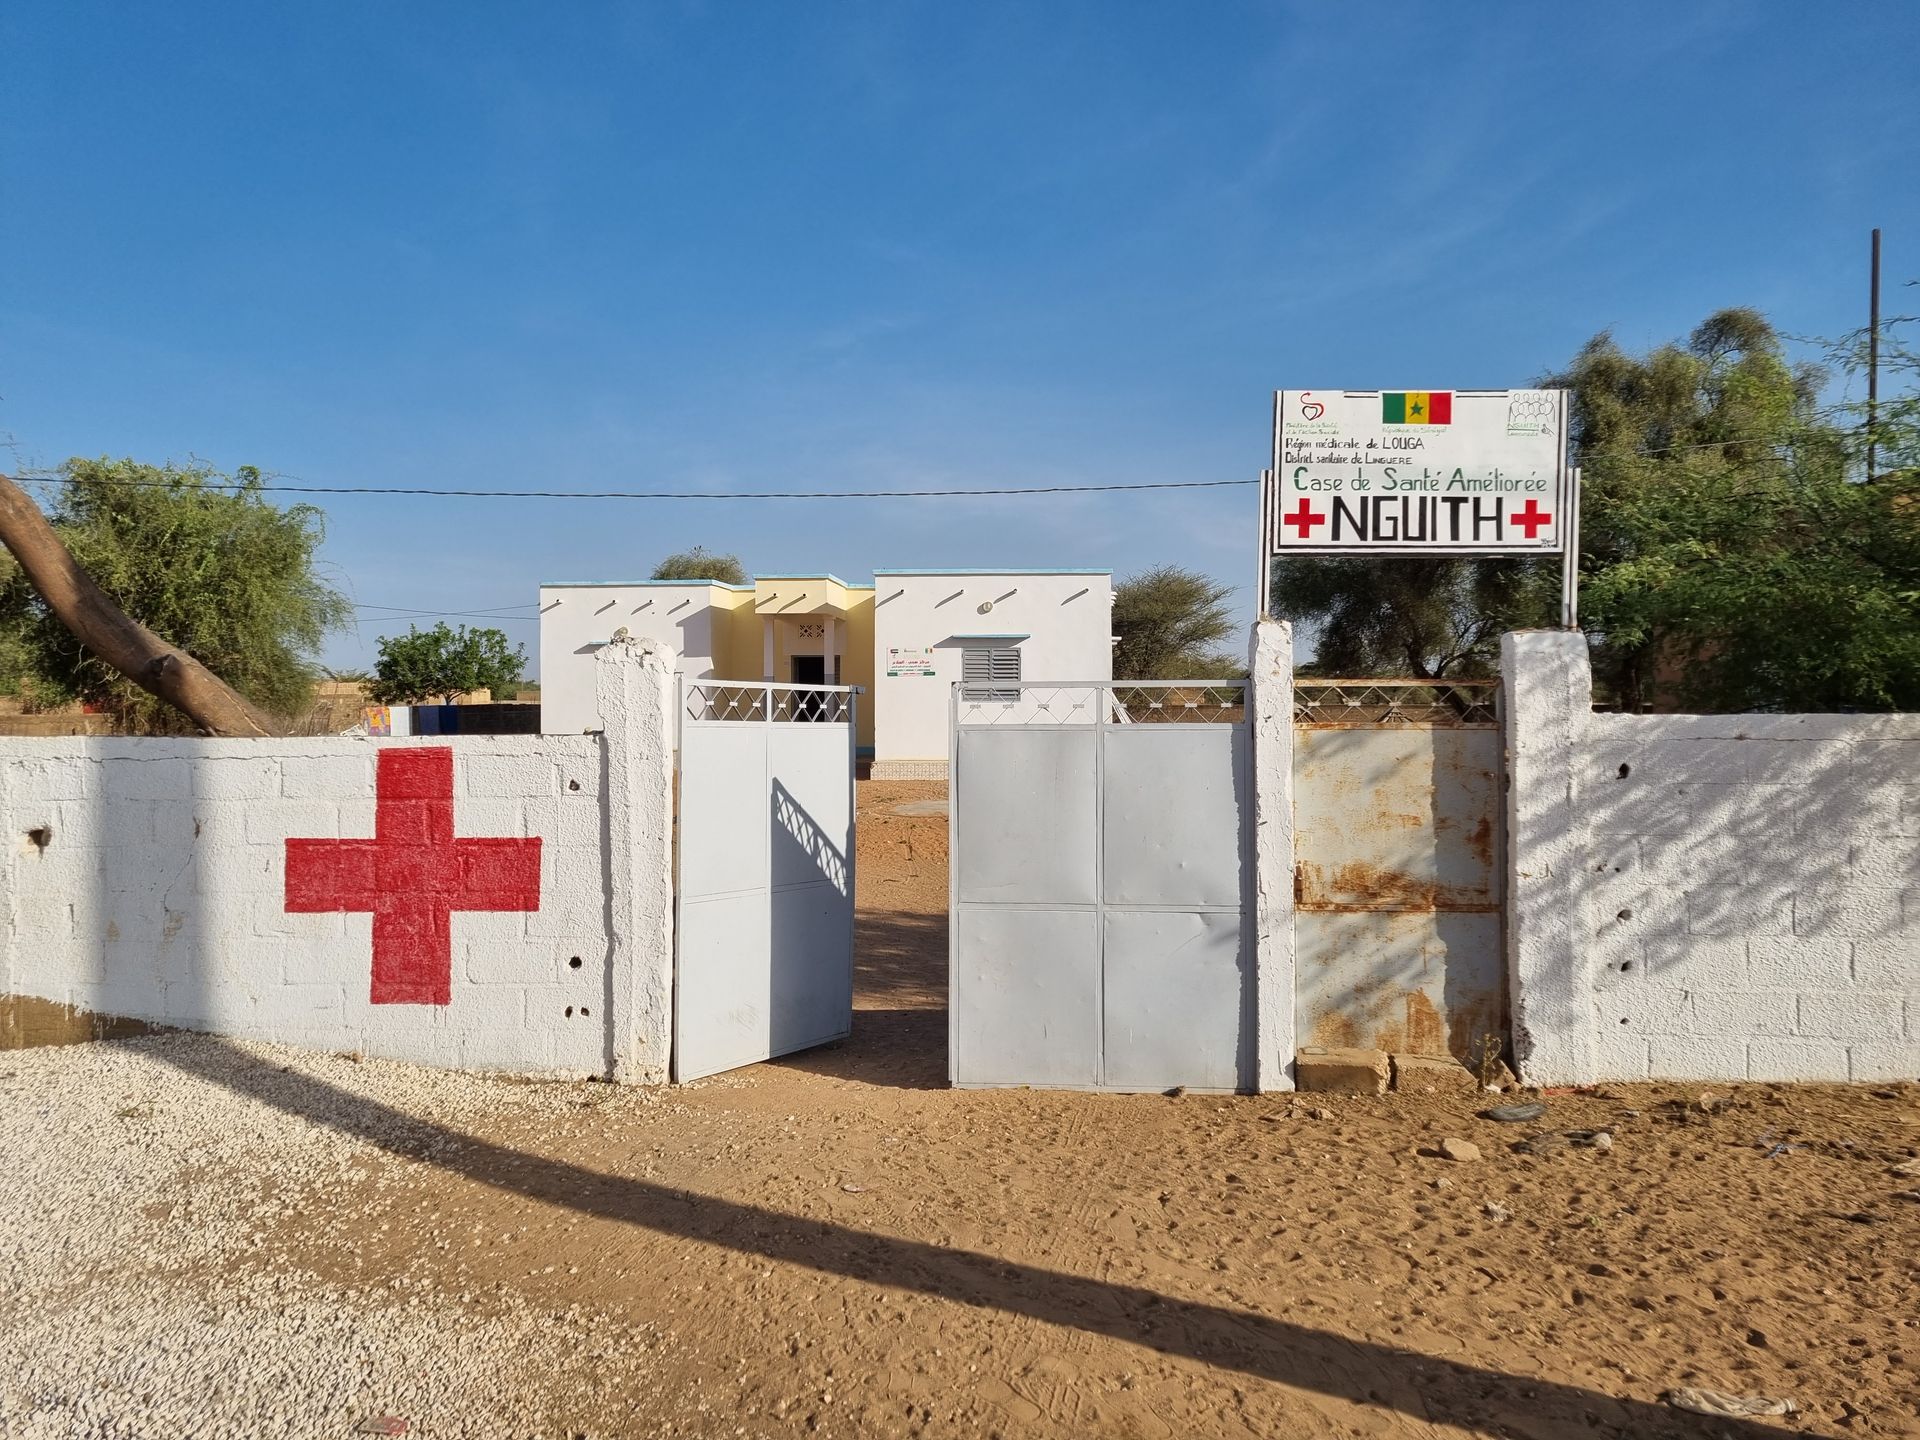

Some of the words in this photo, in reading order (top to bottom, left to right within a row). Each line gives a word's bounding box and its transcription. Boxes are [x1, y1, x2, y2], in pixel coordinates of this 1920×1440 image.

[1285, 438, 1311, 451] Région
[1315, 438, 1360, 449] médicale
[1366, 438, 1378, 449] de
[1382, 437, 1425, 449] LOUGA
[1285, 452, 1313, 464] District
[1316, 452, 1348, 464] sanitaire
[1351, 452, 1361, 464] de
[1294, 466, 1343, 491] Case
[1351, 467, 1371, 491] de
[1382, 467, 1442, 491] Santé
[1446, 467, 1547, 492] Améliorée
[1331, 495, 1504, 541] NGUITH
